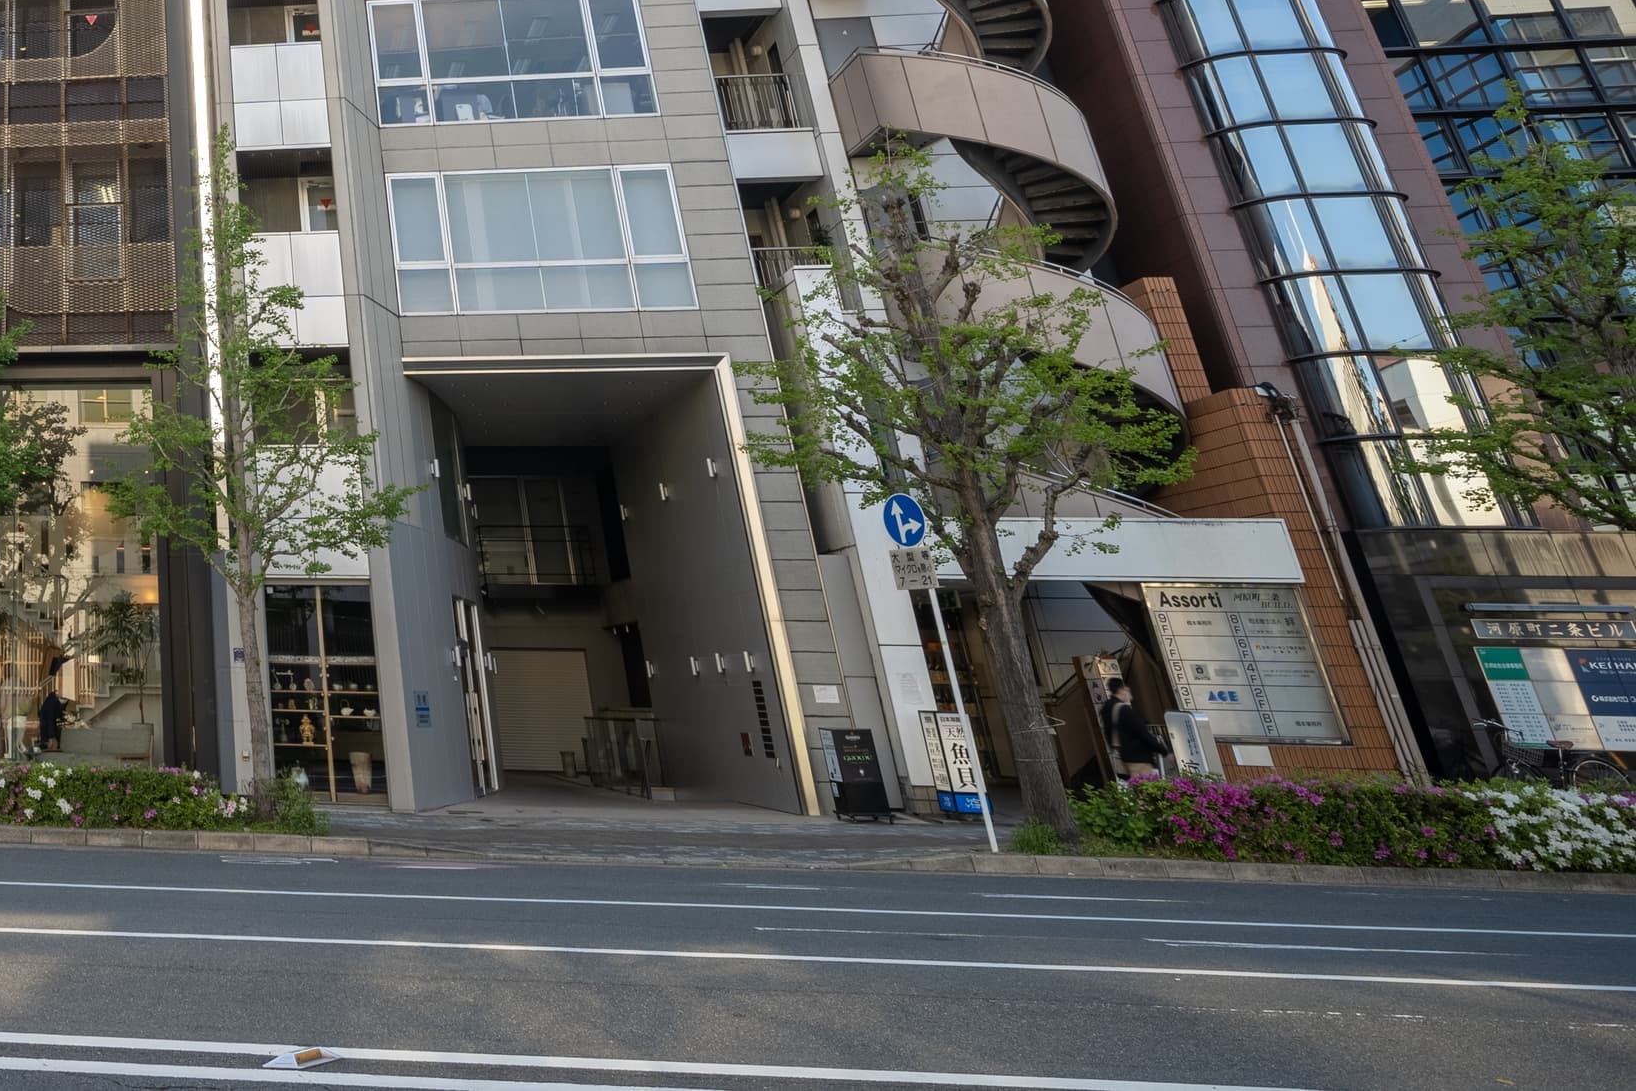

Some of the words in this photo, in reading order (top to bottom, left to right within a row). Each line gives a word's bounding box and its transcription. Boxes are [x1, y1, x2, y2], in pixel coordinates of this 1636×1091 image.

[1160, 591, 1224, 608] Assorti
[1485, 622, 1624, 638] 河原町二条ビル
